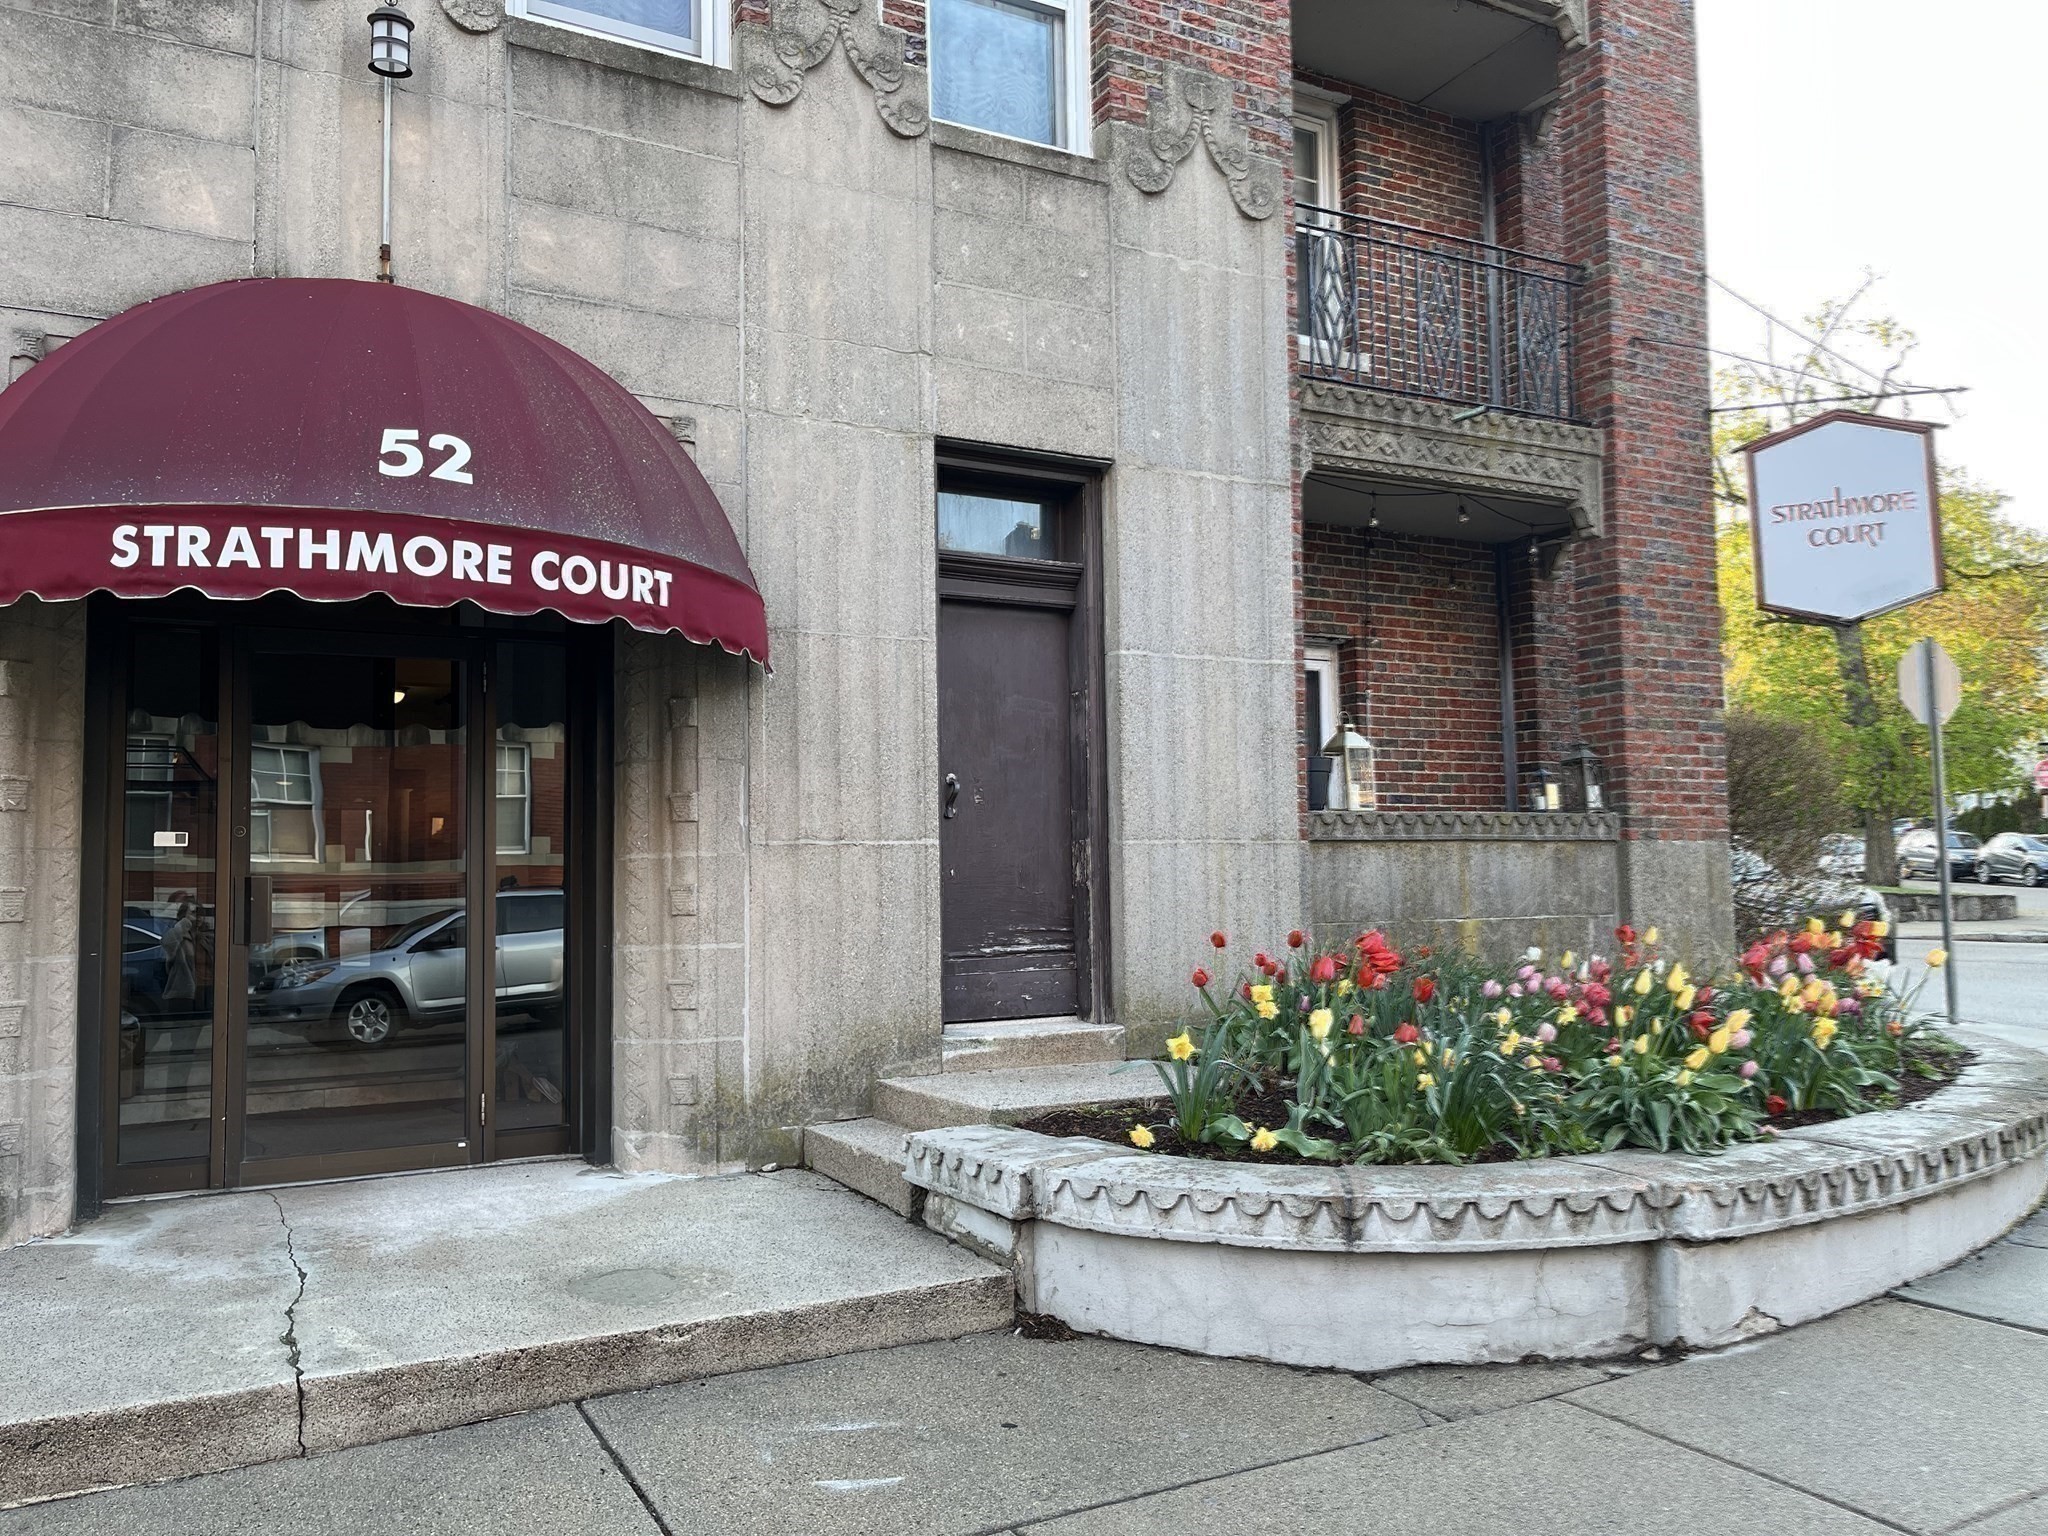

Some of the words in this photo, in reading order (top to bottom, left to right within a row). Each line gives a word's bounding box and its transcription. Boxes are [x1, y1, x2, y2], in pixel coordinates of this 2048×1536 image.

[379, 428, 474, 484] 52
[1771, 487, 1916, 524] STRATHMORE
[1808, 522, 1886, 547] COURT
[110, 525, 512, 584] STRATHMORE
[531, 551, 673, 607] COURT
